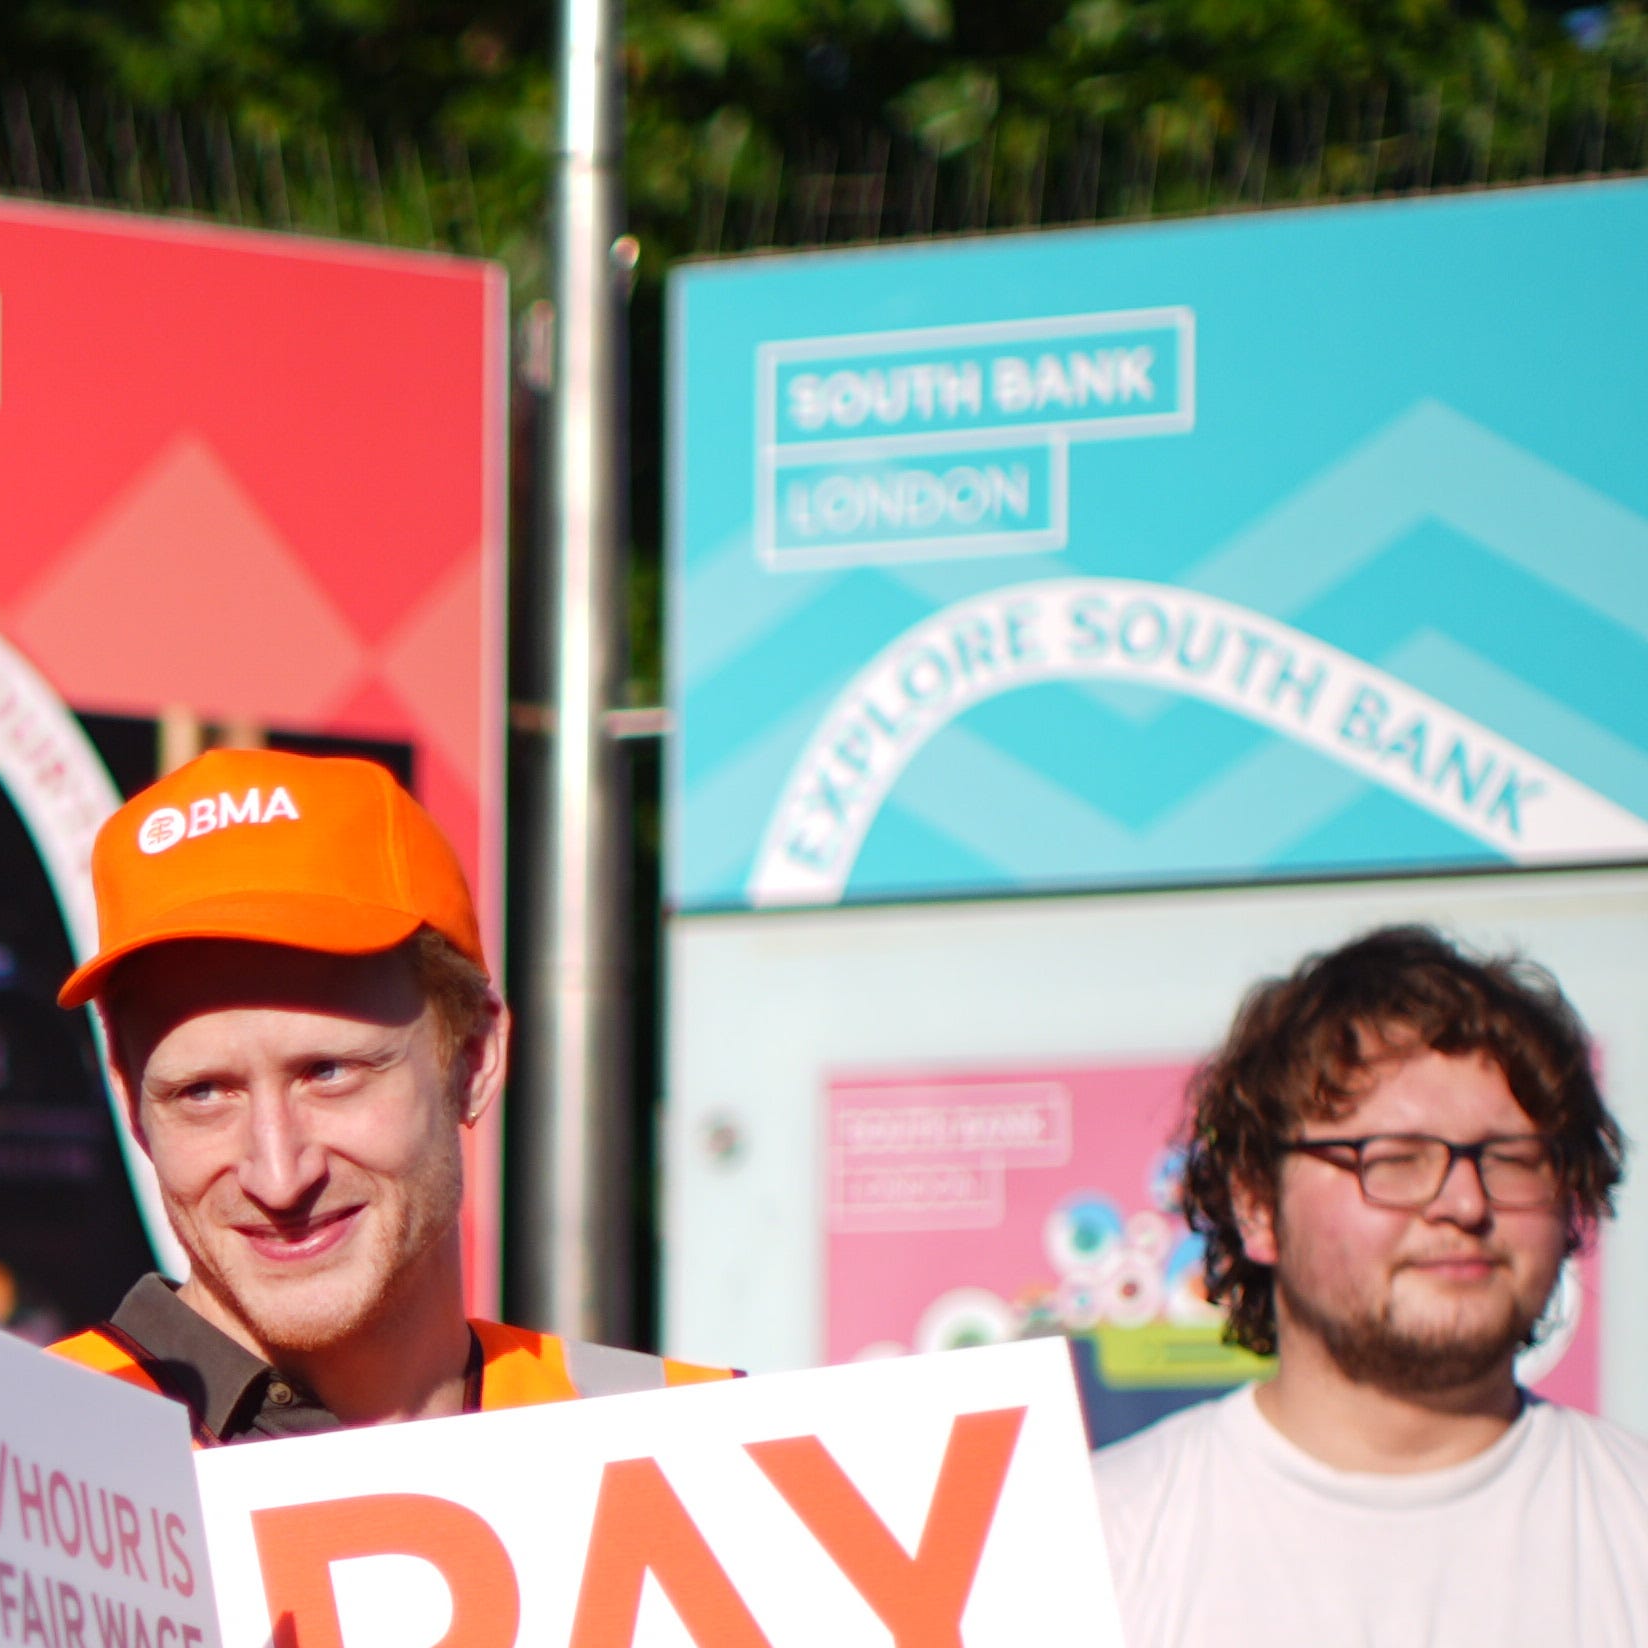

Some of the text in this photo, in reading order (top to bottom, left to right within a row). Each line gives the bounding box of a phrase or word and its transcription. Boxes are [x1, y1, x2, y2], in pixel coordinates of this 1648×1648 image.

[787, 344, 1157, 429] SOUTH BANK
[785, 463, 1031, 537] LONDON
[783, 596, 1557, 873] EXPLORE SOUTH BANK
[187, 786, 300, 839] BMA
[153, 1505, 196, 1598] IS
